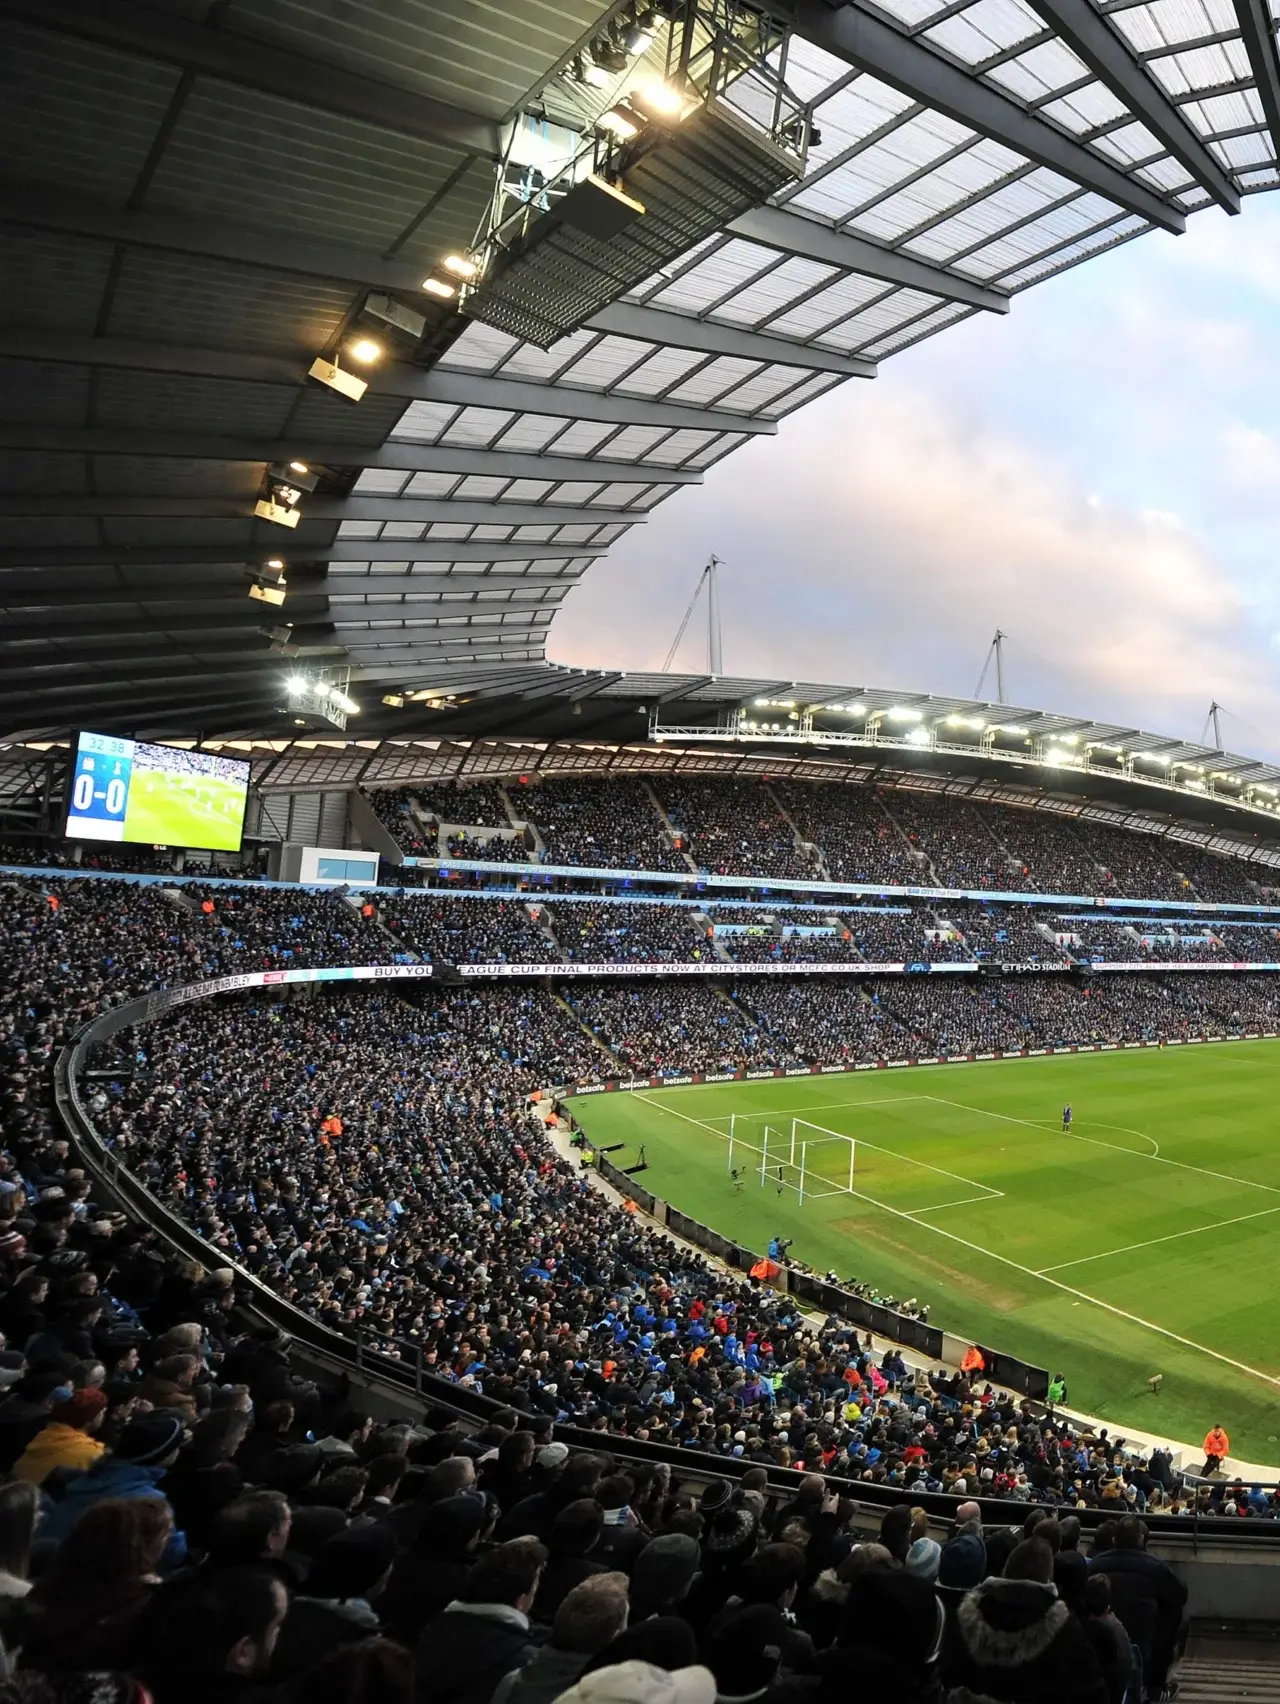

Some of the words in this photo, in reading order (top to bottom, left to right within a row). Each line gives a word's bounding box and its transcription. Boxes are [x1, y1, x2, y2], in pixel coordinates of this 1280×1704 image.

[511, 966, 539, 974] CUP
[588, 965, 658, 973] PRODUCTS
[1002, 963, 1041, 971] ETIHAD
[1042, 963, 1070, 971] STADIUM
[373, 968, 400, 976] BUY
[888, 1059, 909, 1067] betsafe
[918, 1057, 938, 1065] betsafe
[821, 1064, 845, 1072] betsafe
[855, 1062, 878, 1070] betsafe
[746, 1070, 774, 1079] betsafe
[786, 1067, 811, 1075] betsafe
[663, 1076, 692, 1085] betsafe
[705, 1072, 735, 1081] betsafe
[577, 1084, 605, 1094] betsafe
